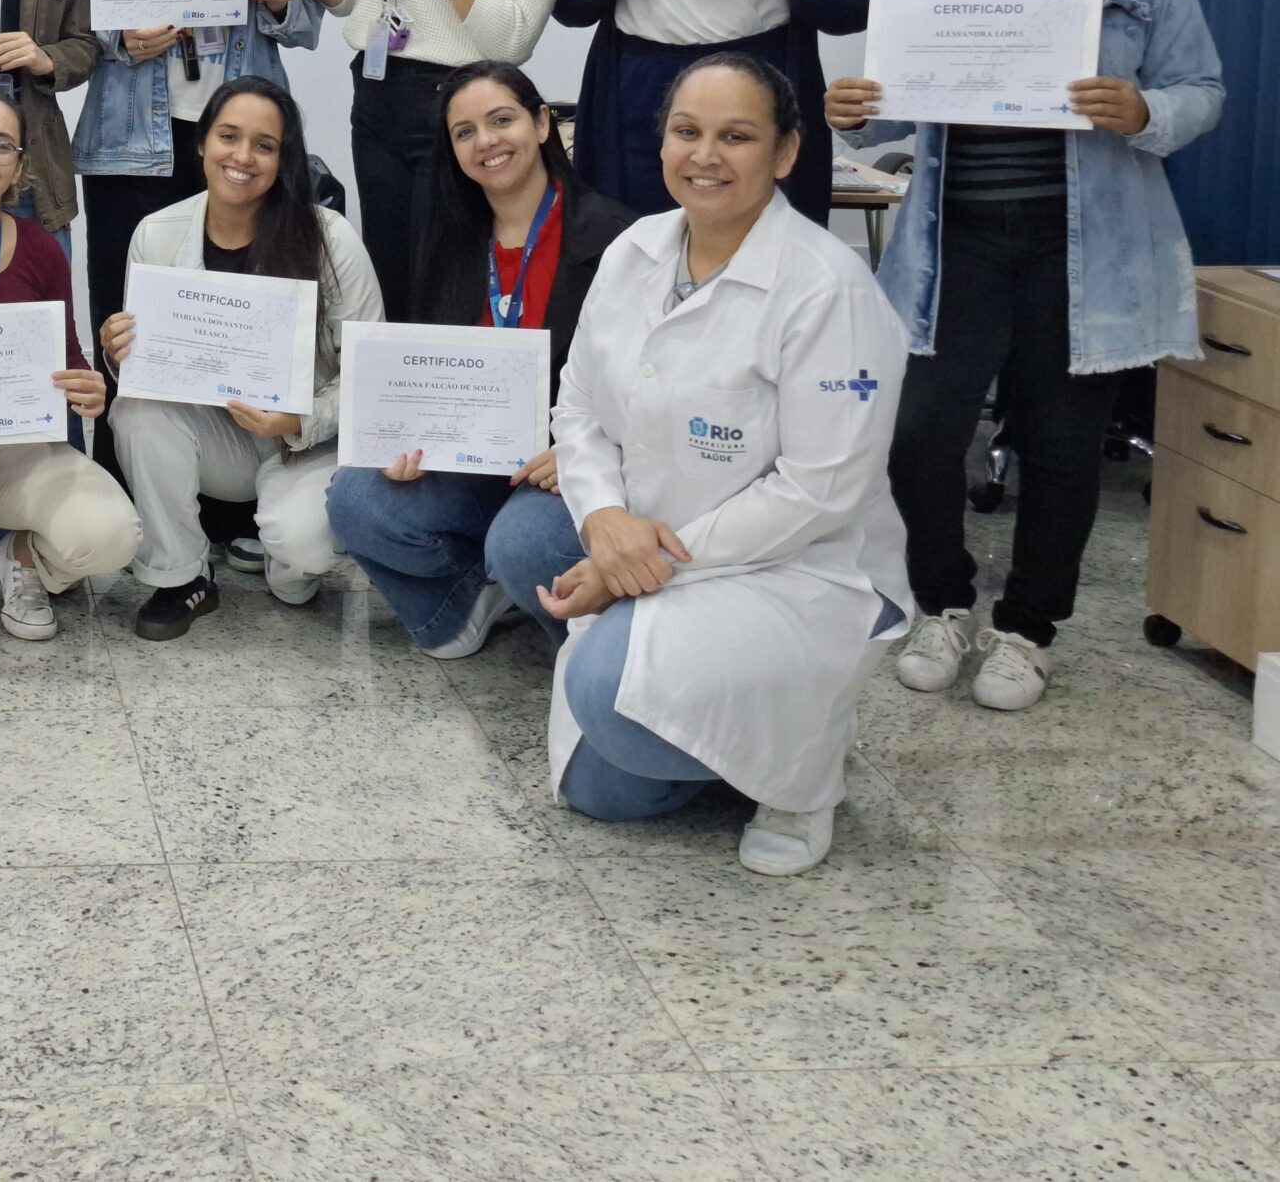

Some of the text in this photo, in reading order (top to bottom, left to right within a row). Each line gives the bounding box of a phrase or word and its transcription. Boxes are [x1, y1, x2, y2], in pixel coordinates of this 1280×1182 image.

[933, 4, 1024, 14] CERTIFICADO
[177, 289, 251, 310] CERTIFICADO
[403, 355, 485, 369] CERTIFICADO
[819, 380, 846, 392] SUS
[710, 425, 743, 441] Rio
[701, 451, 733, 463] SAÚDE
